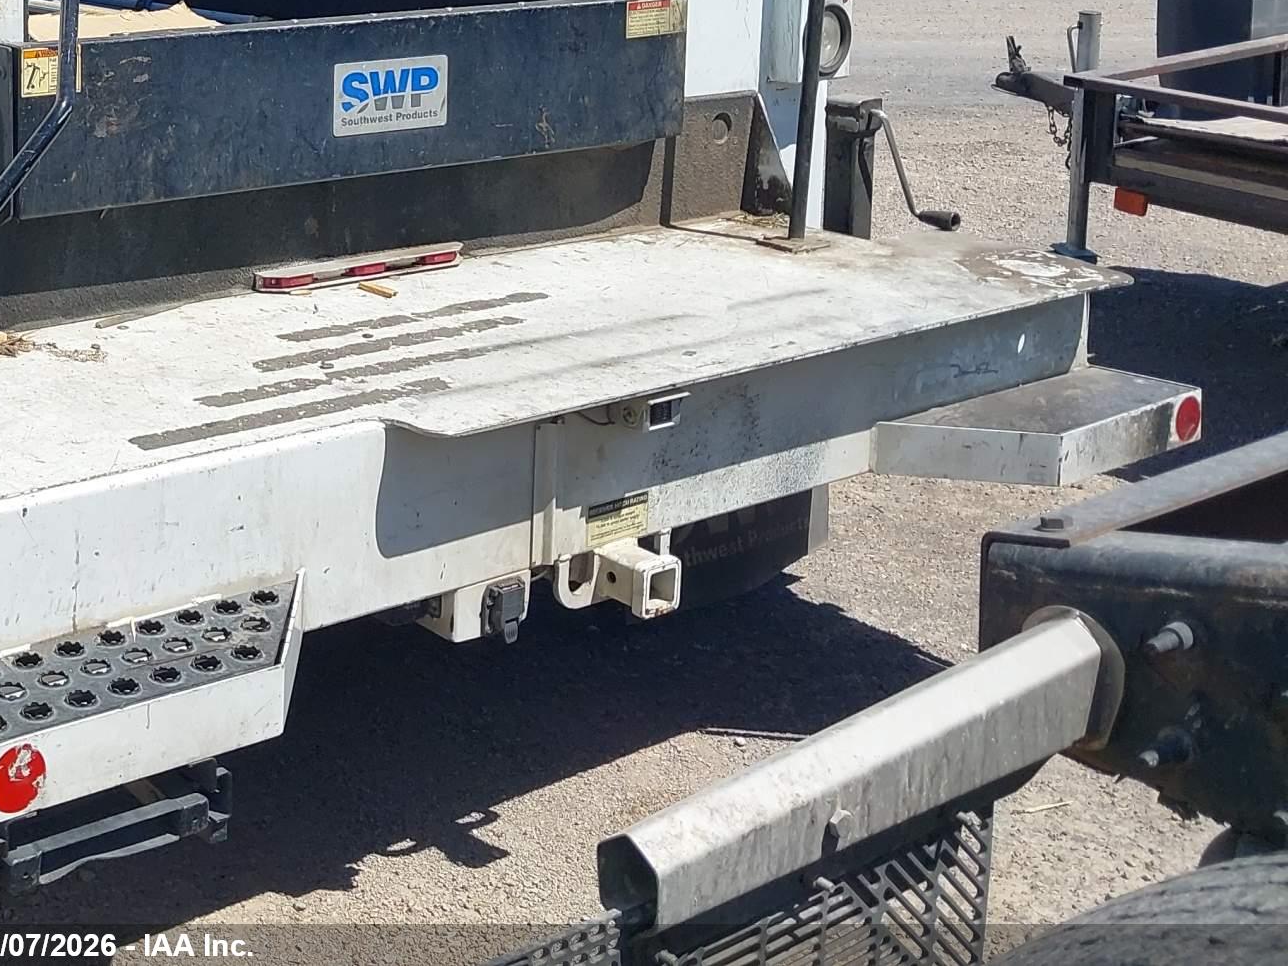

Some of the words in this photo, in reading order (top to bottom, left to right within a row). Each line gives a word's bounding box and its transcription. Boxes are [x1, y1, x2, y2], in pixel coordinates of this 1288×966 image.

[341, 66, 439, 112] SWP
[341, 114, 393, 127] Southwest
[396, 109, 439, 122] Products
